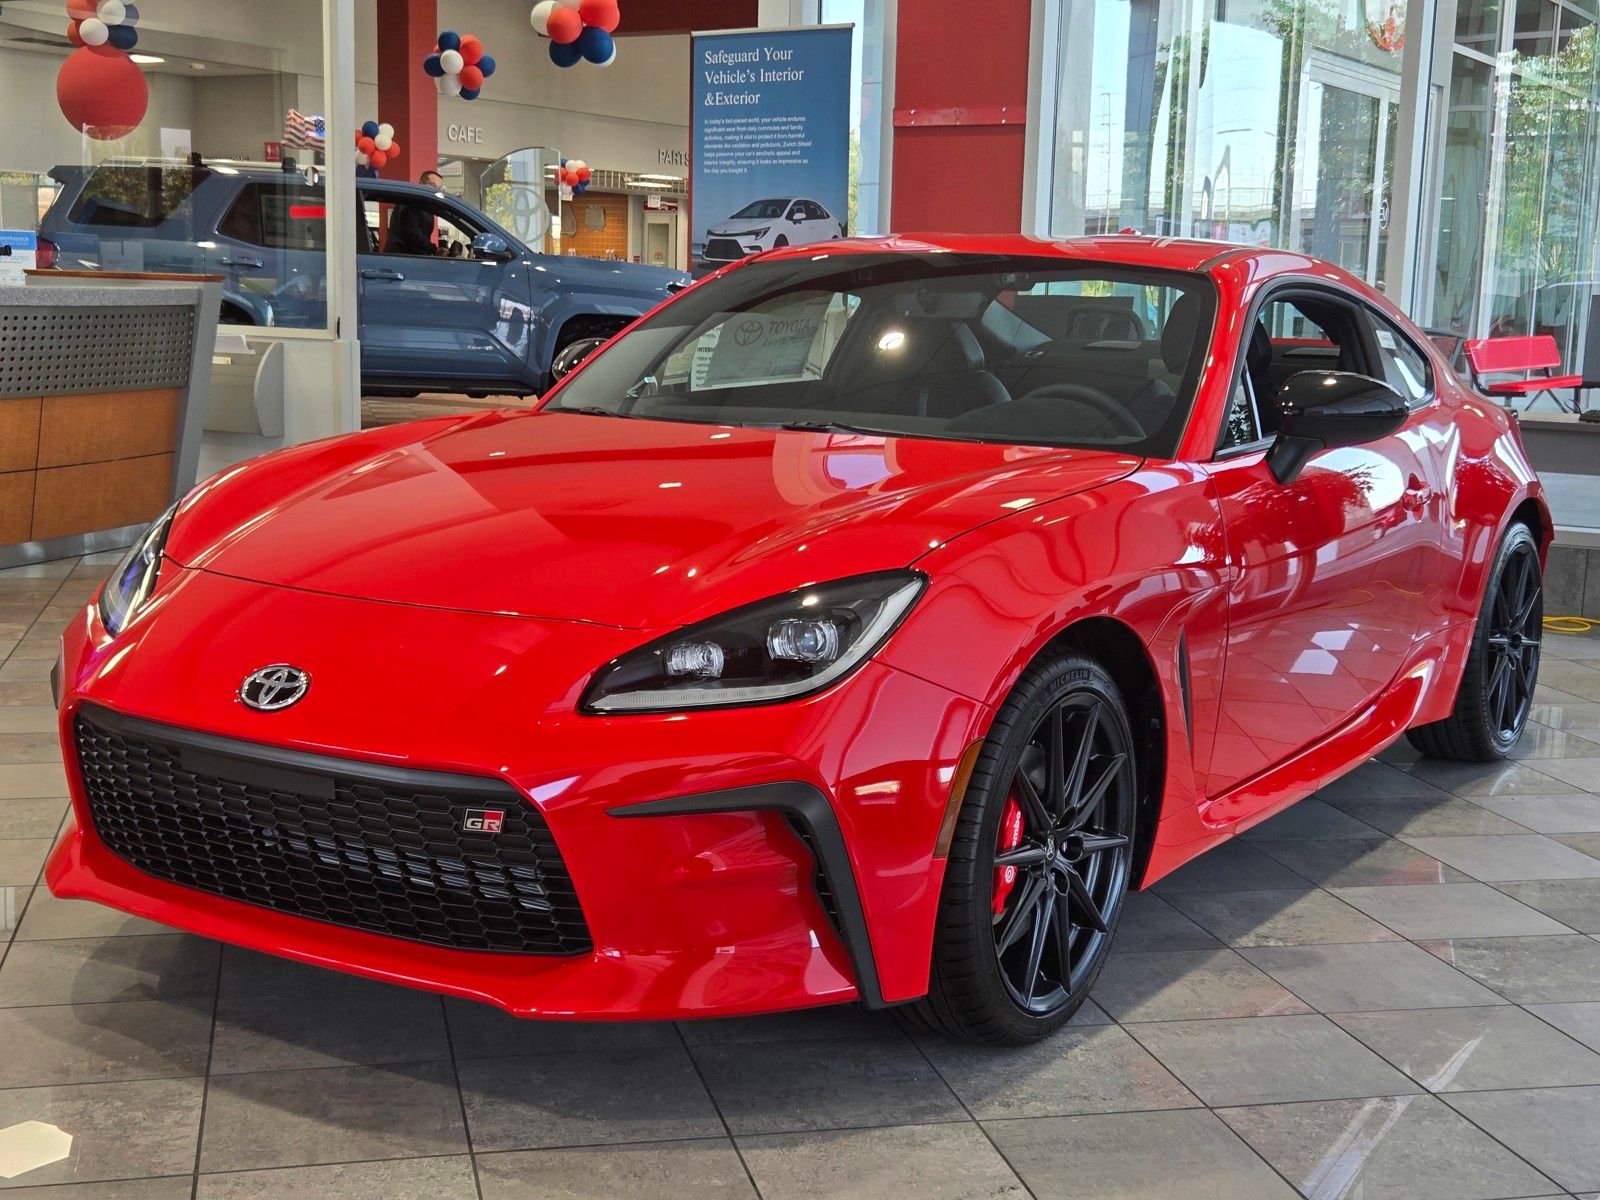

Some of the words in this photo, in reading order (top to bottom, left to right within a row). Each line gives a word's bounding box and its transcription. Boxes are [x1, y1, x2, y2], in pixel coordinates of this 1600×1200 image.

[705, 48, 759, 66] Safeguard
[764, 47, 793, 61] Your
[704, 69, 756, 85] Vehicle's
[760, 67, 804, 82] Interior
[704, 91, 761, 106] &Exterior
[448, 123, 484, 145] CAFE
[658, 148, 690, 167] PARTS
[769, 318, 810, 335] TOYOTA
[1049, 668, 1090, 692] MICHELIN
[466, 817, 500, 831] GR
